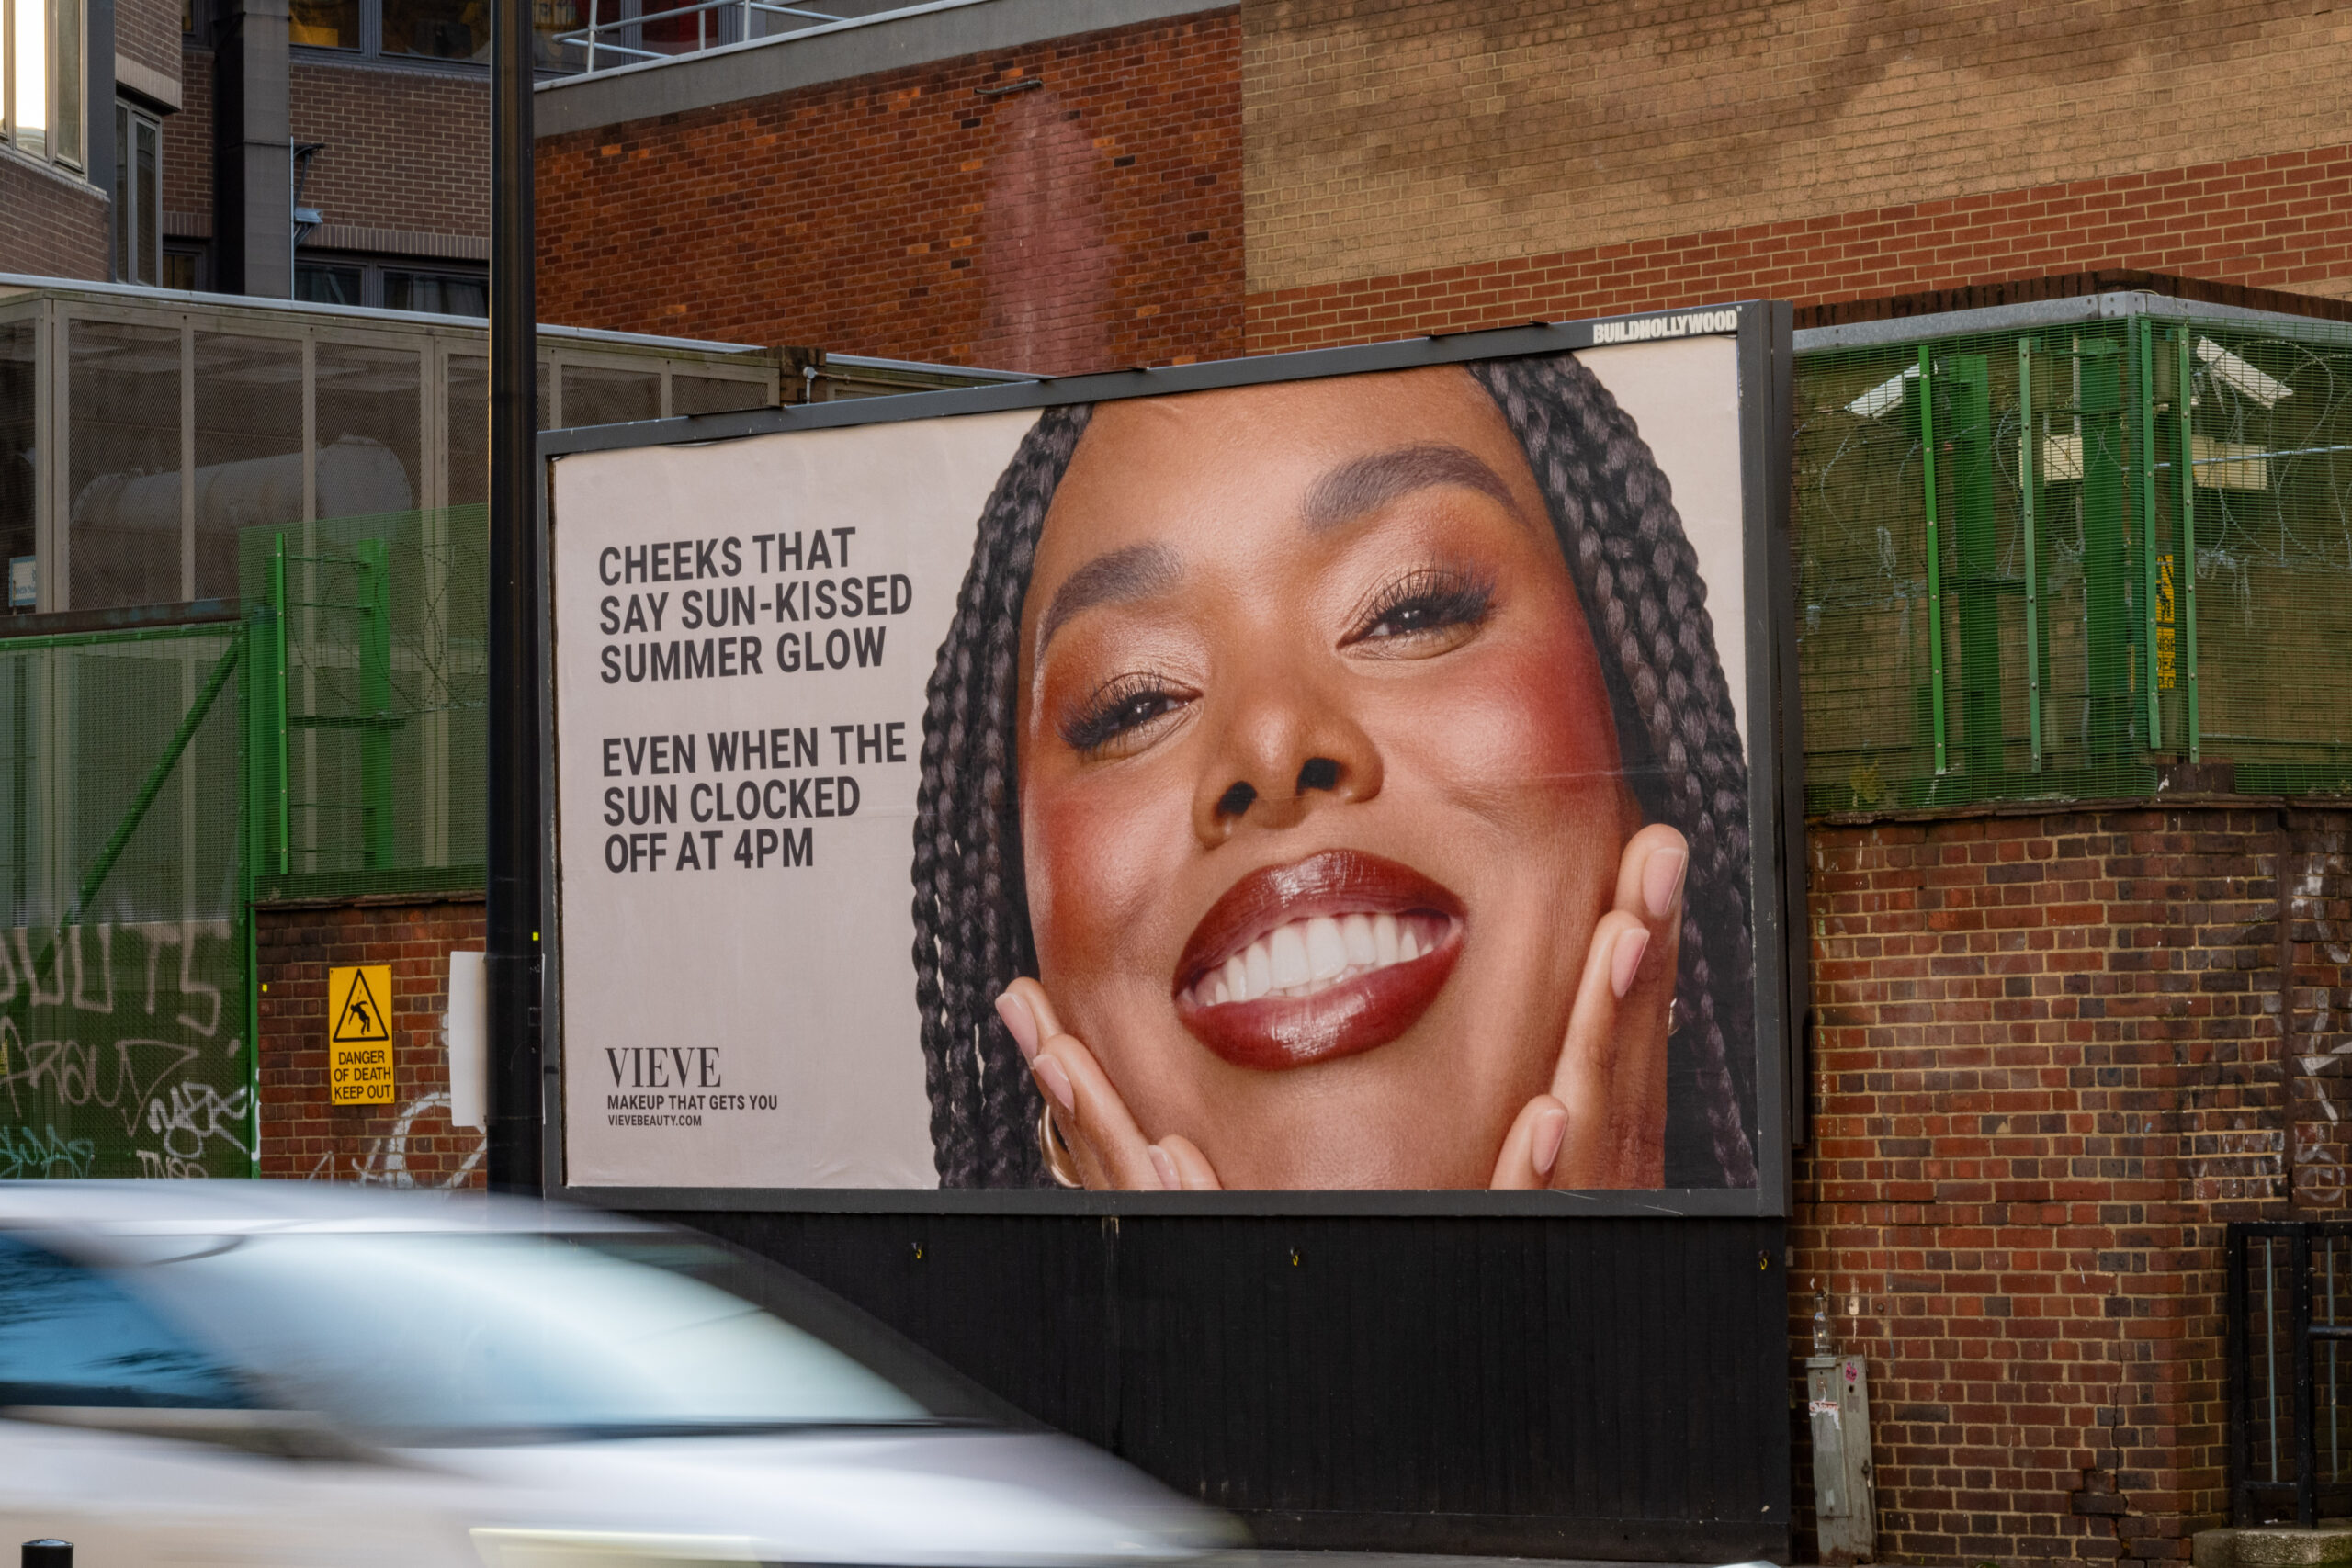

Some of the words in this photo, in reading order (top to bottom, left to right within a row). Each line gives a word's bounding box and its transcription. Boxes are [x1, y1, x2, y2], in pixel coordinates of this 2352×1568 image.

[600, 537, 742, 586] CHEEKS
[753, 527, 855, 573] THAT
[600, 592, 669, 635] SAY
[682, 574, 912, 628] SUN-KISSED
[601, 636, 762, 683] SUMMER
[777, 626, 886, 672] GLOW
[603, 734, 695, 777] EVEN
[707, 727, 818, 771] WHEN
[831, 722, 906, 765] THE
[604, 785, 677, 826] SUN
[691, 776, 860, 821] CLOCKED
[605, 833, 666, 873] OFF
[676, 830, 723, 870] AT
[734, 828, 813, 868] 4PM
[334, 1068, 349, 1082] OF
[354, 1067, 391, 1081] DEATH
[338, 1051, 385, 1065] DANGER
[605, 1047, 721, 1088] VIEVE
[334, 1086, 364, 1100] KEEP
[368, 1085, 390, 1099] OUT
[608, 1095, 664, 1110] MAKEUP
[669, 1095, 706, 1110] THAT
[709, 1095, 744, 1110] GETS
[750, 1095, 777, 1110] YOU
[608, 1115, 702, 1126] VIEVEBEAUTY.COM
